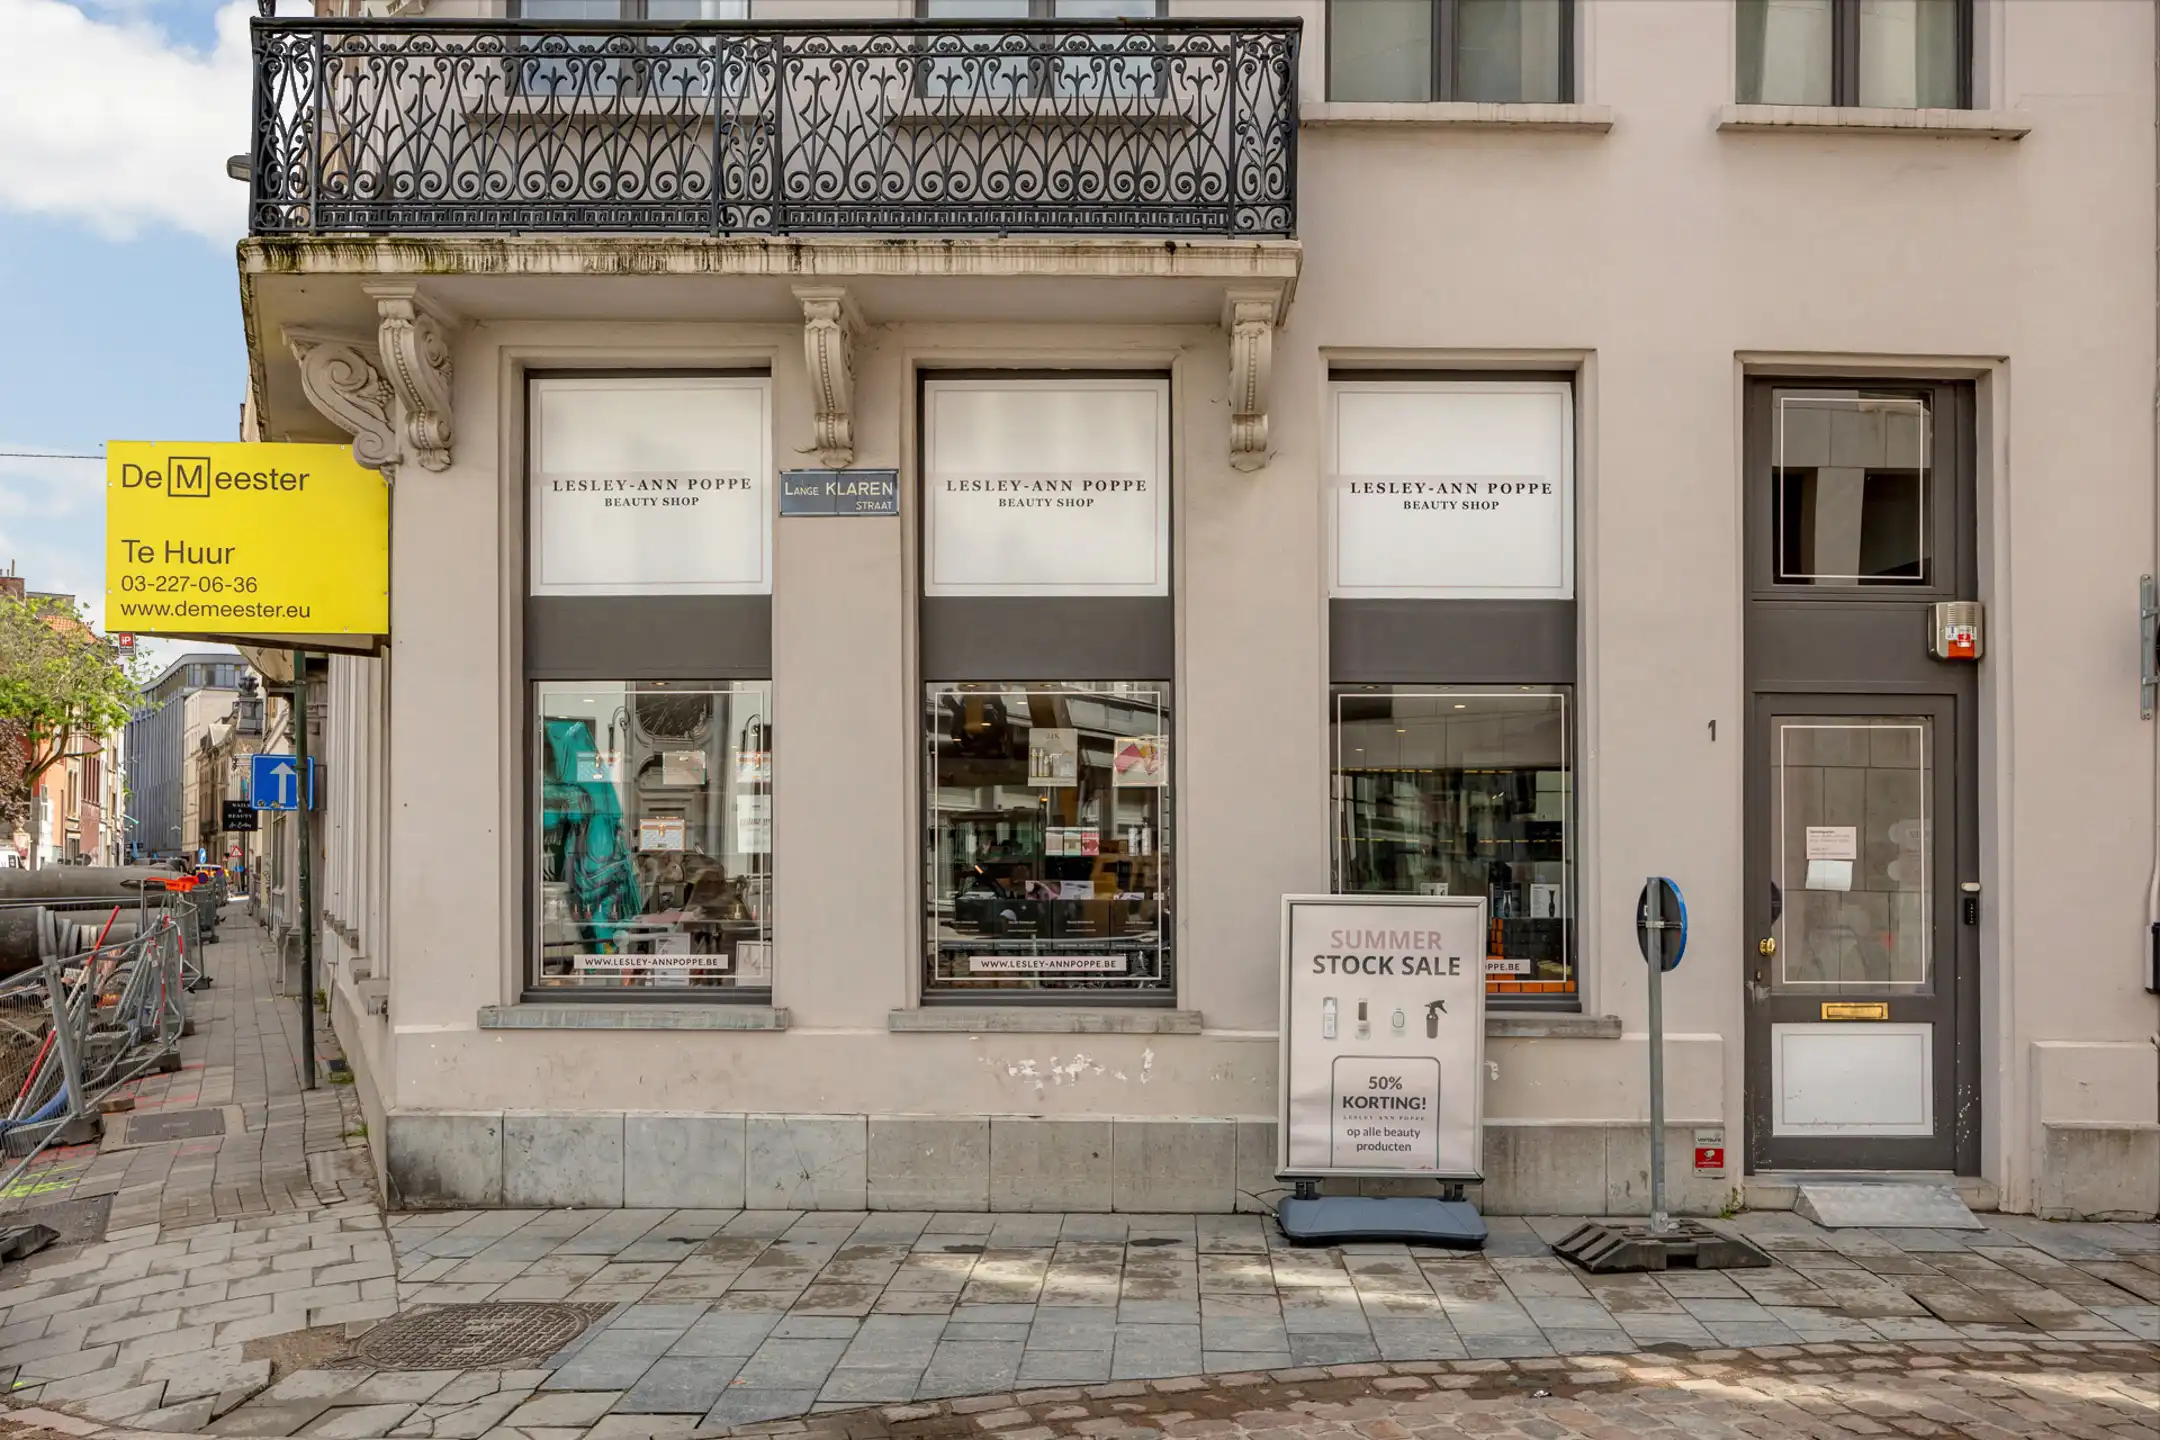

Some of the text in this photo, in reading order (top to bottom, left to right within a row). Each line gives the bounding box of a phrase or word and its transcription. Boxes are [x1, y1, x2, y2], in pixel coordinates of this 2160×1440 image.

[553, 478, 752, 492] LESLEY-ANN POPPE
[825, 481, 893, 496] KLAREN
[947, 479, 1147, 492] LESLEY-ANN POPPE
[1350, 482, 1552, 495] LESLEY-ANN POPPE
[605, 496, 700, 508] BEAUTY SHOP
[855, 500, 893, 511] STRAAT
[998, 498, 1094, 508] BEAUTY SHOP
[1403, 500, 1500, 510] BEAUTY SHOP
[121, 539, 236, 565] Te Huur
[120, 575, 258, 594] 03-227-06-36
[120, 601, 311, 619] www.demeester.eu
[1331, 930, 1443, 951] SUMMER
[584, 957, 718, 967] WWW.LESLEY-ANNPOPPE.BE
[980, 960, 1117, 969] WWW.LESLEY-ANNPOPPE.BE
[1312, 955, 1461, 977] STOCK SALE
[1368, 1076, 1403, 1091] 50%
[1342, 1096, 1426, 1110] KORTING!
[1347, 1127, 1421, 1140] op alle beauty
[1356, 1141, 1412, 1153] producten
